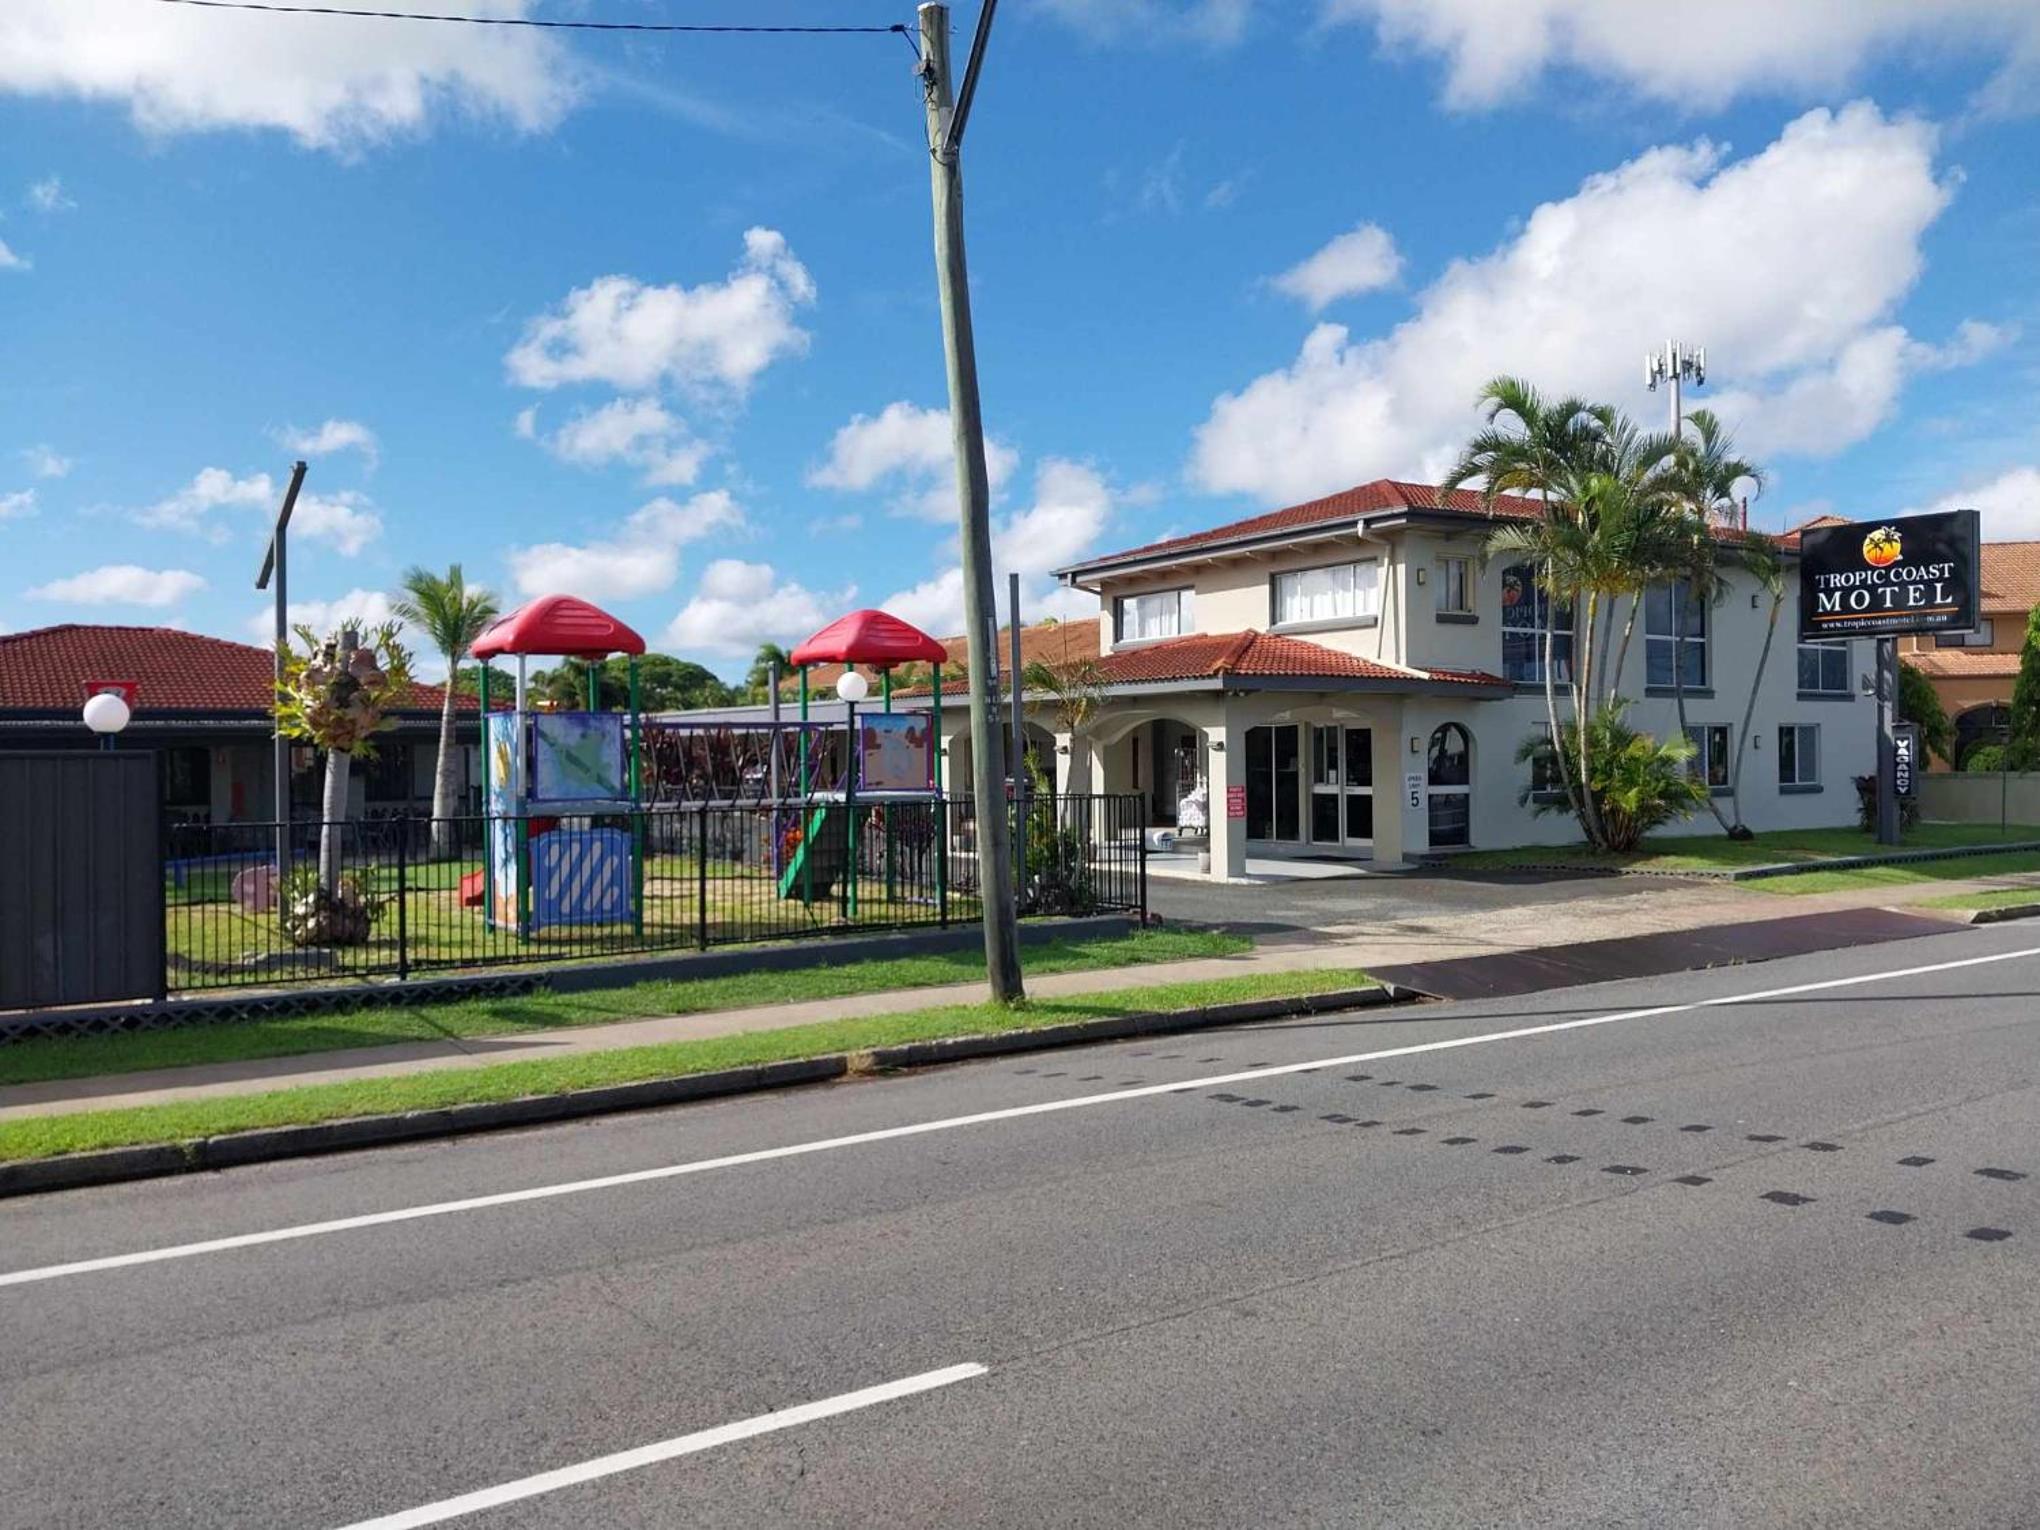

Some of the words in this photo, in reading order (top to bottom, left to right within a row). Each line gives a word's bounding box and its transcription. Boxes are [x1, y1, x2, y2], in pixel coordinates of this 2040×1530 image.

[1815, 569, 1885, 588] TROPIC
[1889, 562, 1954, 582] COAST
[1816, 582, 1953, 612] MOTEL
[1821, 614, 1948, 629] www.tropiccoastmotel.m.au
[1896, 739, 1909, 794] VACANCY
[1411, 790, 1420, 807] 5
